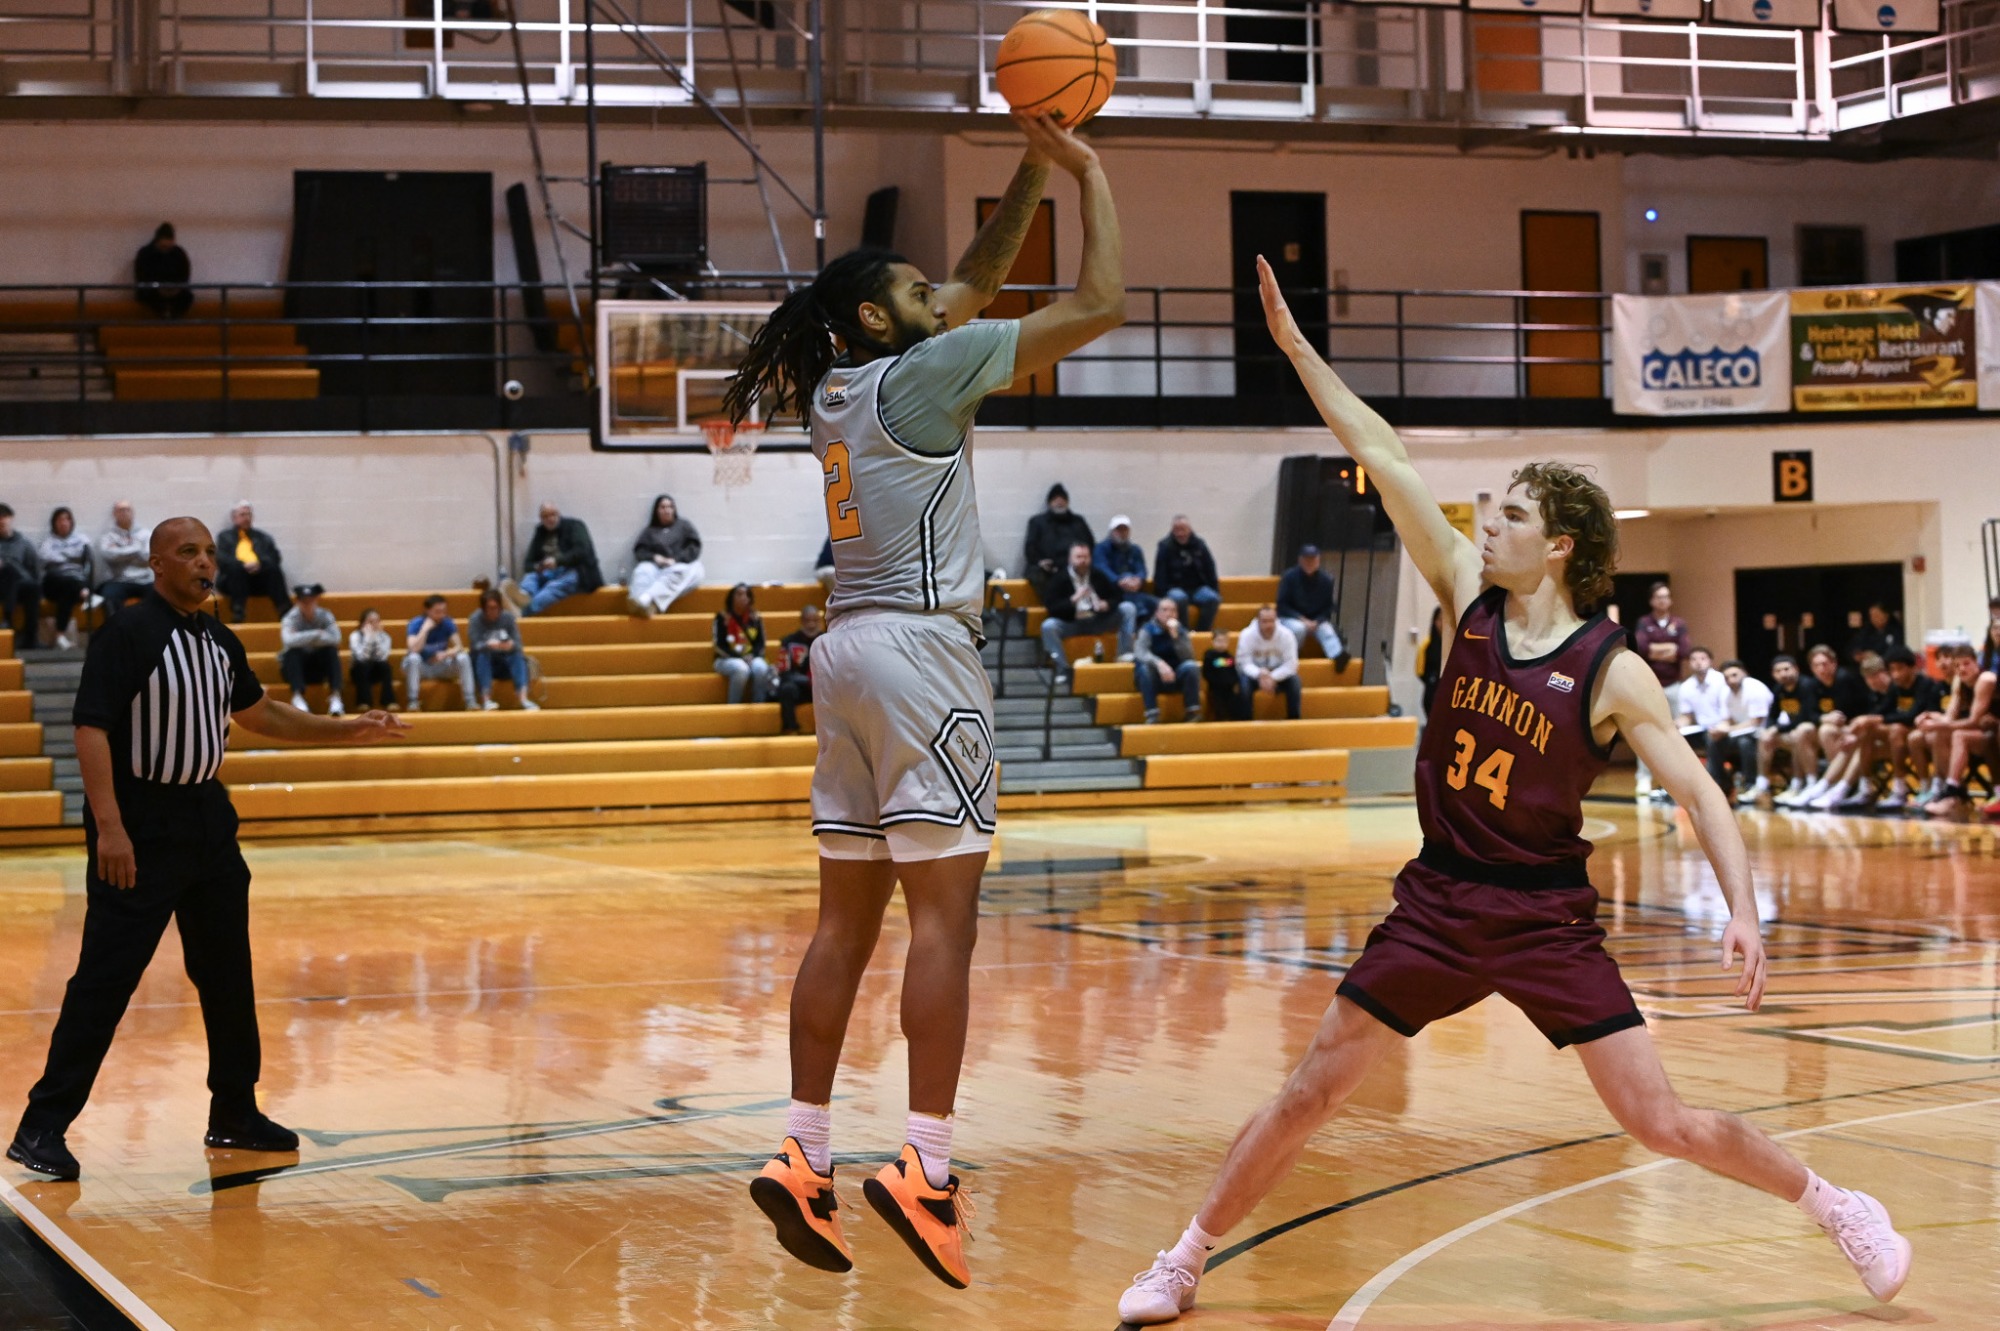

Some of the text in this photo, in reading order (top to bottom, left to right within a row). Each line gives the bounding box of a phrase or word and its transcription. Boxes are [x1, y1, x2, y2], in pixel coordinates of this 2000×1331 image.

[1878, 338, 1966, 358] Restaurant
[1645, 357, 1757, 388] CALECO
[823, 440, 864, 544] 2
[1779, 459, 1808, 497] B
[1550, 676, 1573, 688] PSAC
[1451, 676, 1554, 755] GANNON
[1446, 728, 1516, 811] 34
